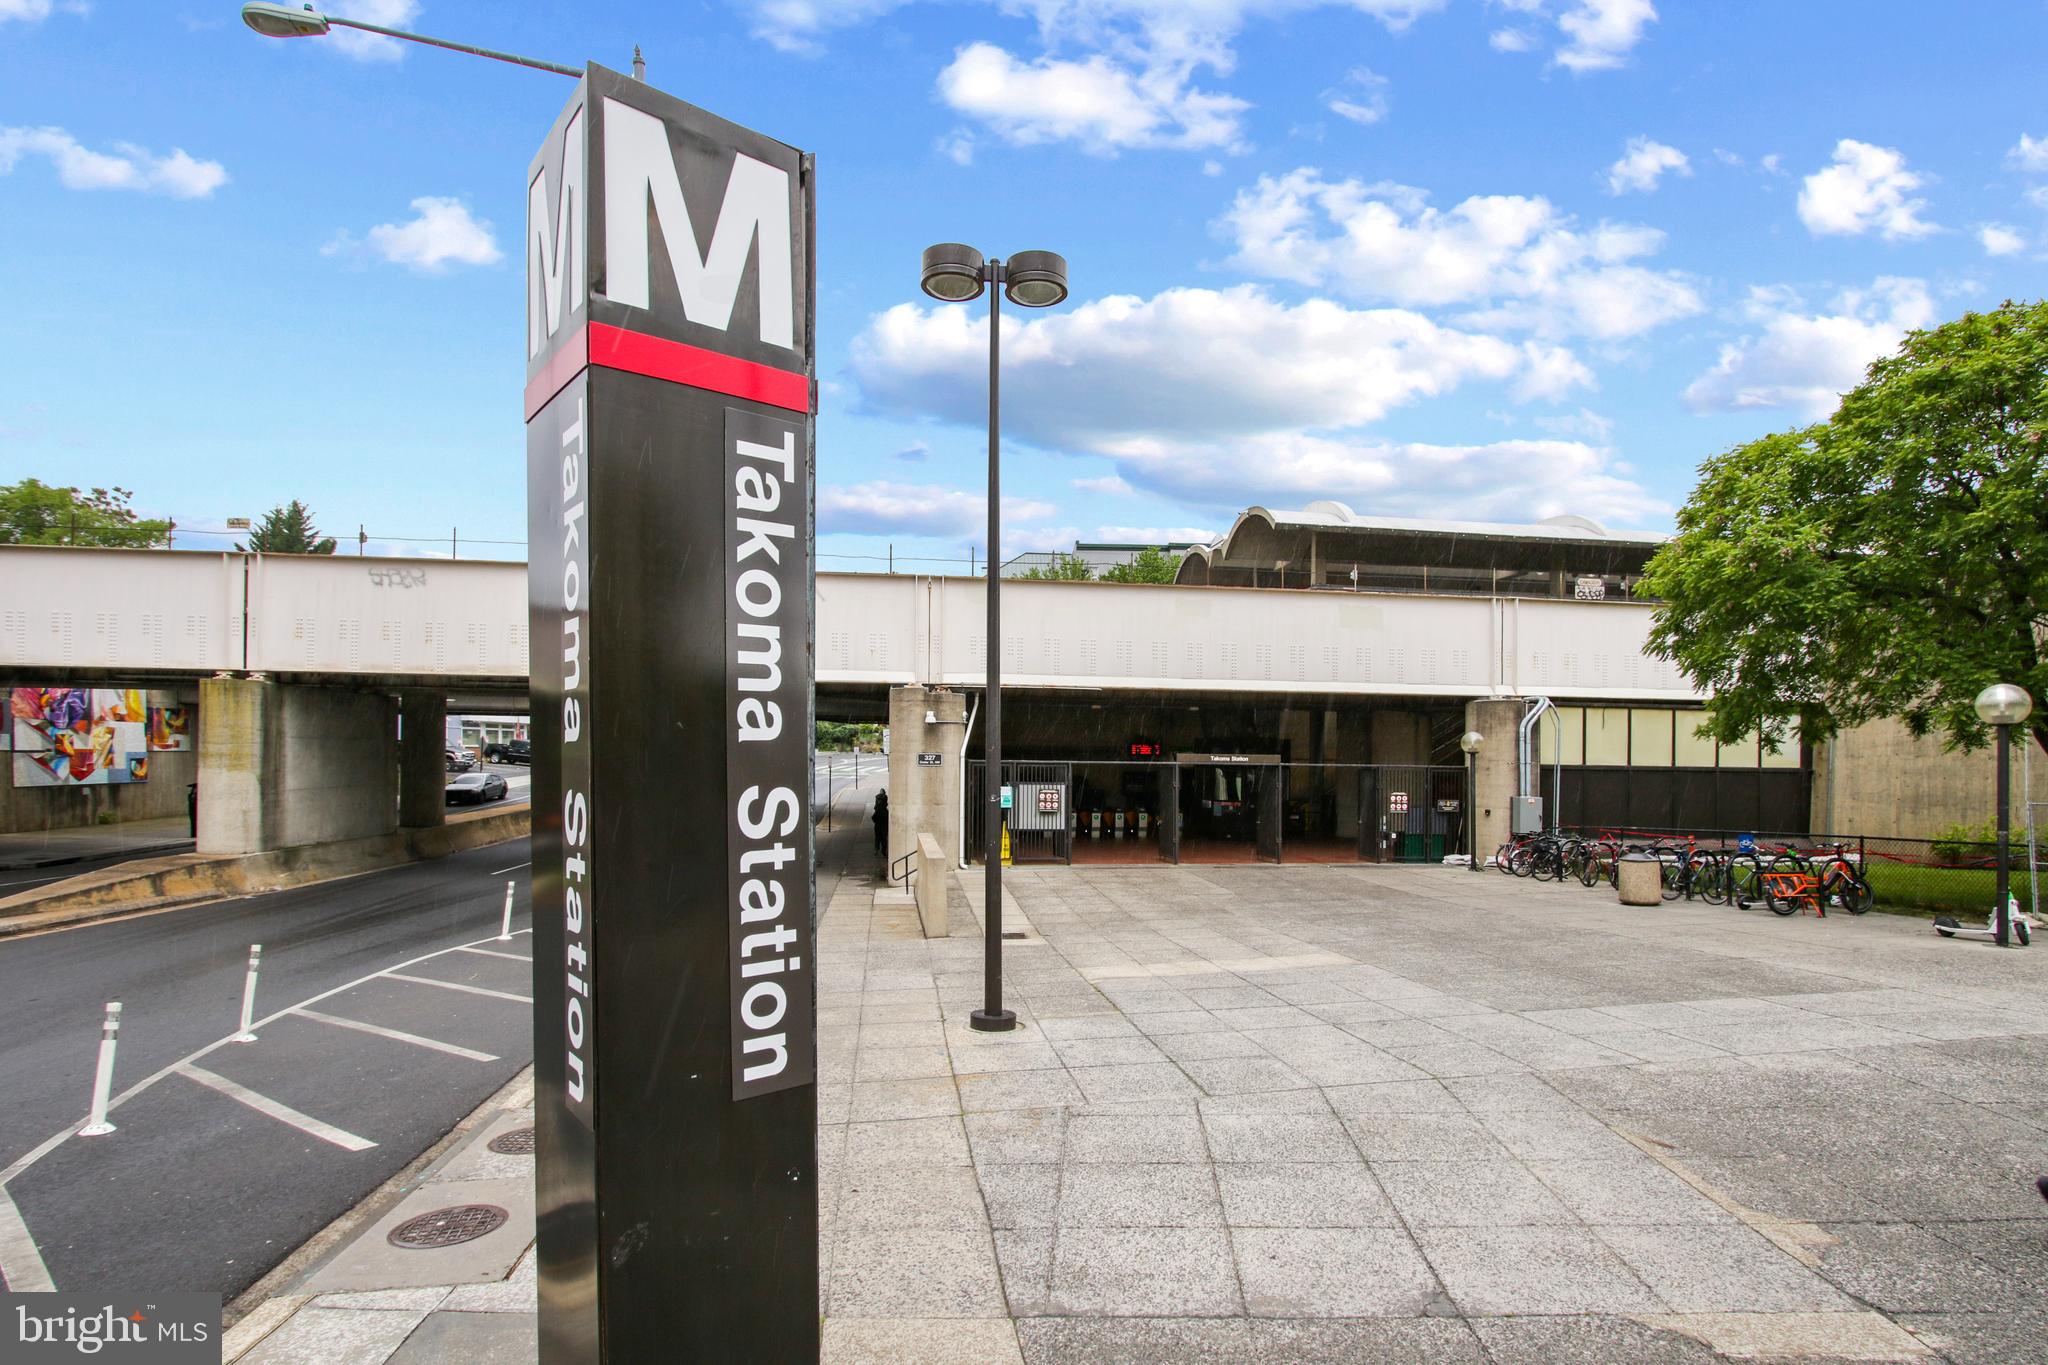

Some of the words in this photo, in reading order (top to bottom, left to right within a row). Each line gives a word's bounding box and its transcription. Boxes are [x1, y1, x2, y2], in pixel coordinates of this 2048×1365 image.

[528, 102, 583, 362] M
[603, 95, 794, 350] M
[562, 397, 584, 743] Takoma
[735, 432, 795, 743] Takoma
[564, 788, 587, 1103] Station
[737, 785, 800, 1082] Station
